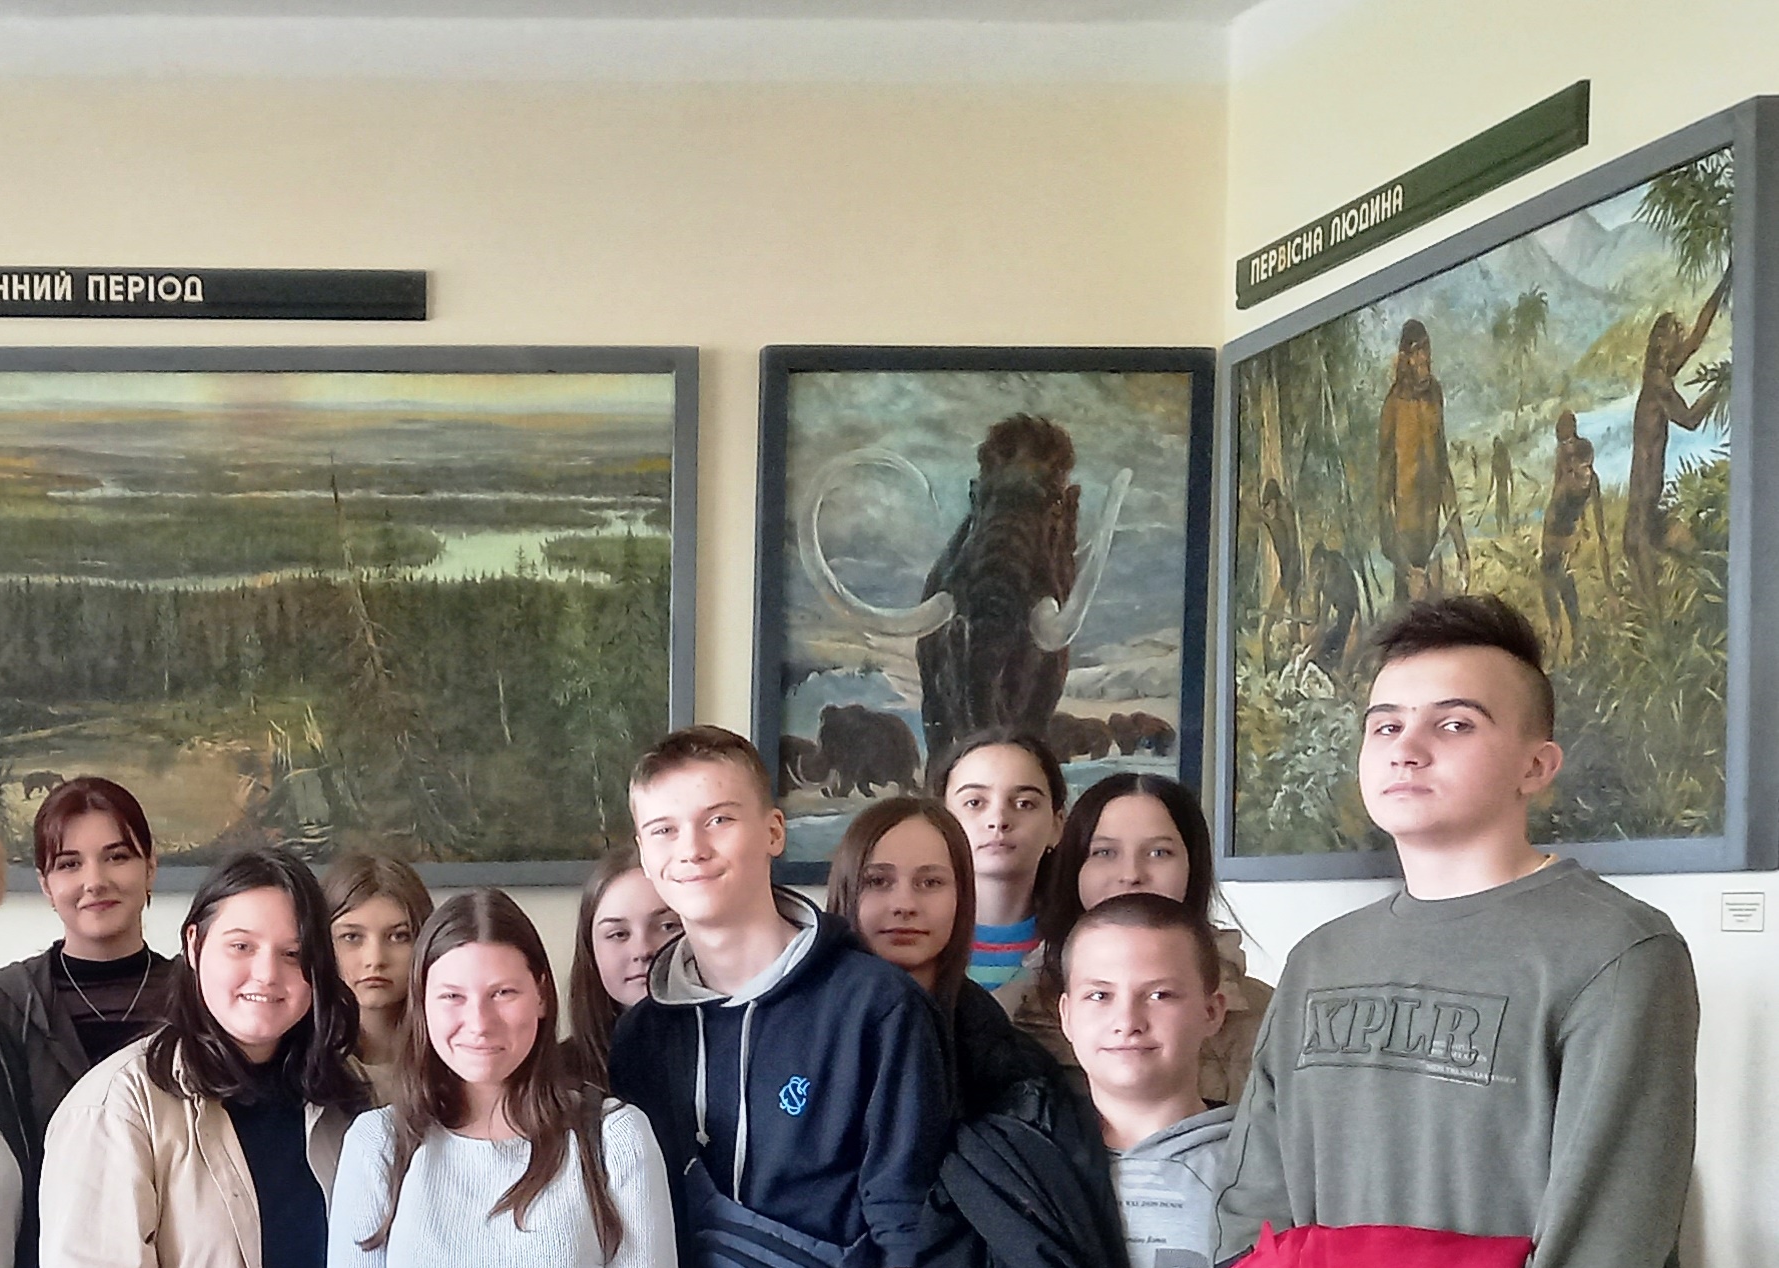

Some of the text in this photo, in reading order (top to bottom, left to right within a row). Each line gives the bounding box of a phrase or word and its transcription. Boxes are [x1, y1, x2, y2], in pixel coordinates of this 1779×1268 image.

[1250, 184, 1404, 286] ПЕРВІСНА ЛЮДИНА
[87, 273, 204, 302] ПЕРІОД
[1303, 997, 1481, 1067] XPLR
